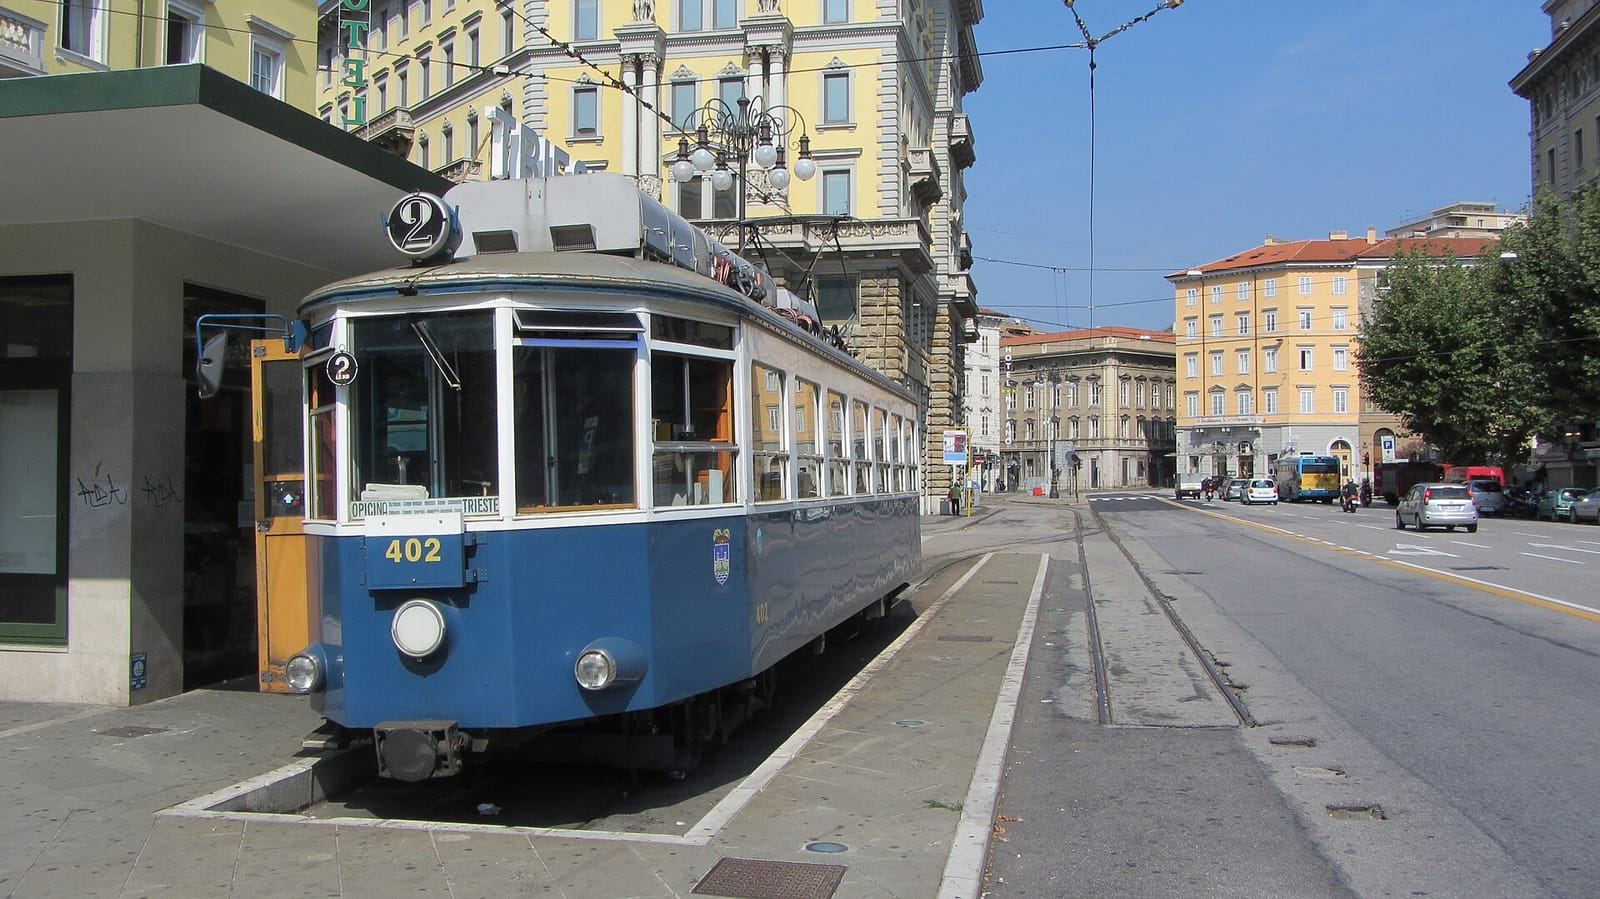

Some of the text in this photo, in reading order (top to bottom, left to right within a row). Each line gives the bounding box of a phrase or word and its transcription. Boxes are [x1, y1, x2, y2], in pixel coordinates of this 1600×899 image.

[400, 197, 432, 249] 2
[335, 356, 350, 380] 2
[352, 502, 388, 518] OPICINA
[463, 497, 499, 513] TRIESTE
[385, 538, 441, 563] 402
[756, 602, 769, 624] 402
